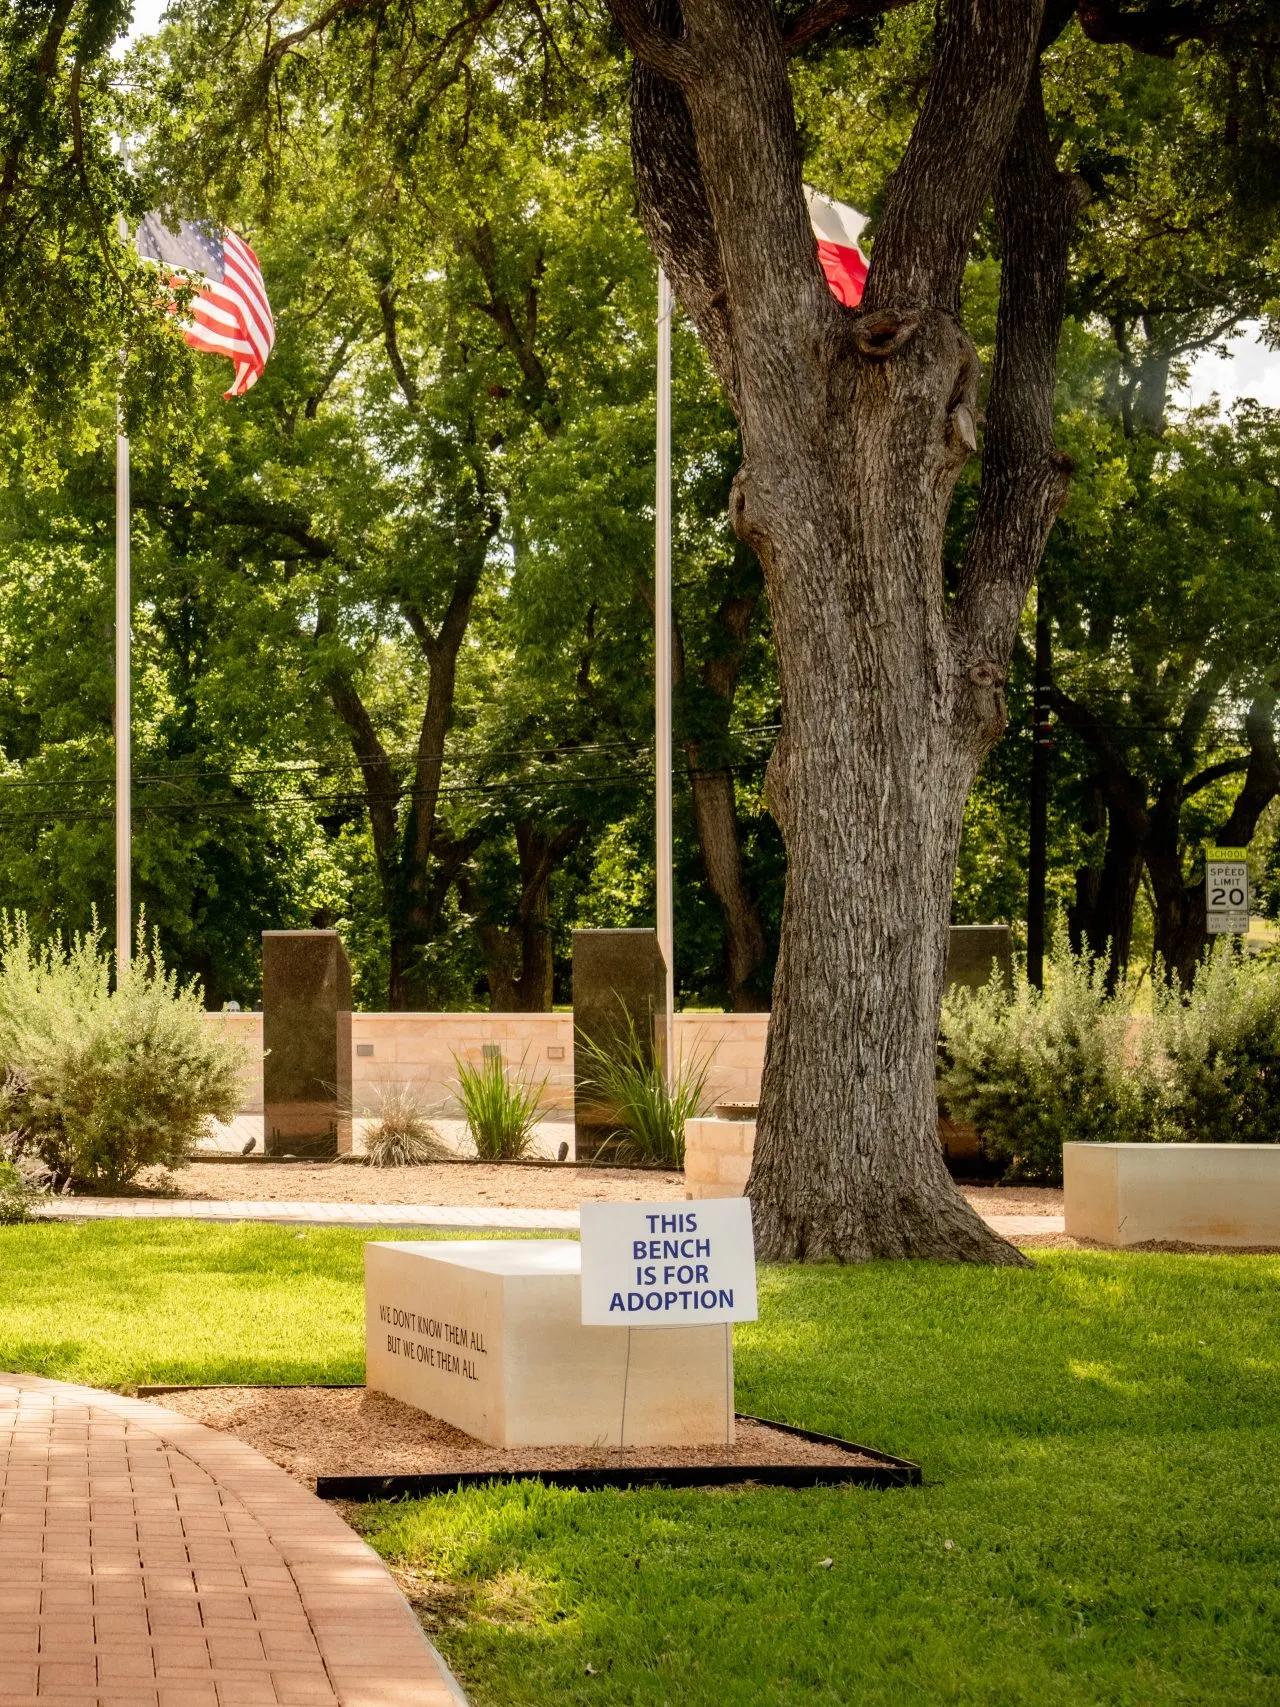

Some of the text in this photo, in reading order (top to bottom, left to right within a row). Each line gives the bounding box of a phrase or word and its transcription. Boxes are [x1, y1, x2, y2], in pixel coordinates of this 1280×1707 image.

[1209, 849, 1245, 858] SCHOOL
[1210, 868, 1245, 877] SPEED
[1213, 878, 1240, 886] LIMIT
[1211, 888, 1244, 906] 20
[645, 1213, 698, 1234] THIS
[633, 1238, 711, 1260] BENCH
[636, 1264, 709, 1286] IS FOR
[608, 1288, 734, 1312] ADOPTION
[380, 1304, 391, 1324] WE
[393, 1308, 416, 1332] DON'T
[417, 1315, 443, 1339] KNOW
[445, 1323, 468, 1348] THEM
[387, 1335, 401, 1355] BUT
[402, 1339, 415, 1360] WE
[416, 1344, 435, 1367] OWE
[436, 1350, 460, 1375] THEM
